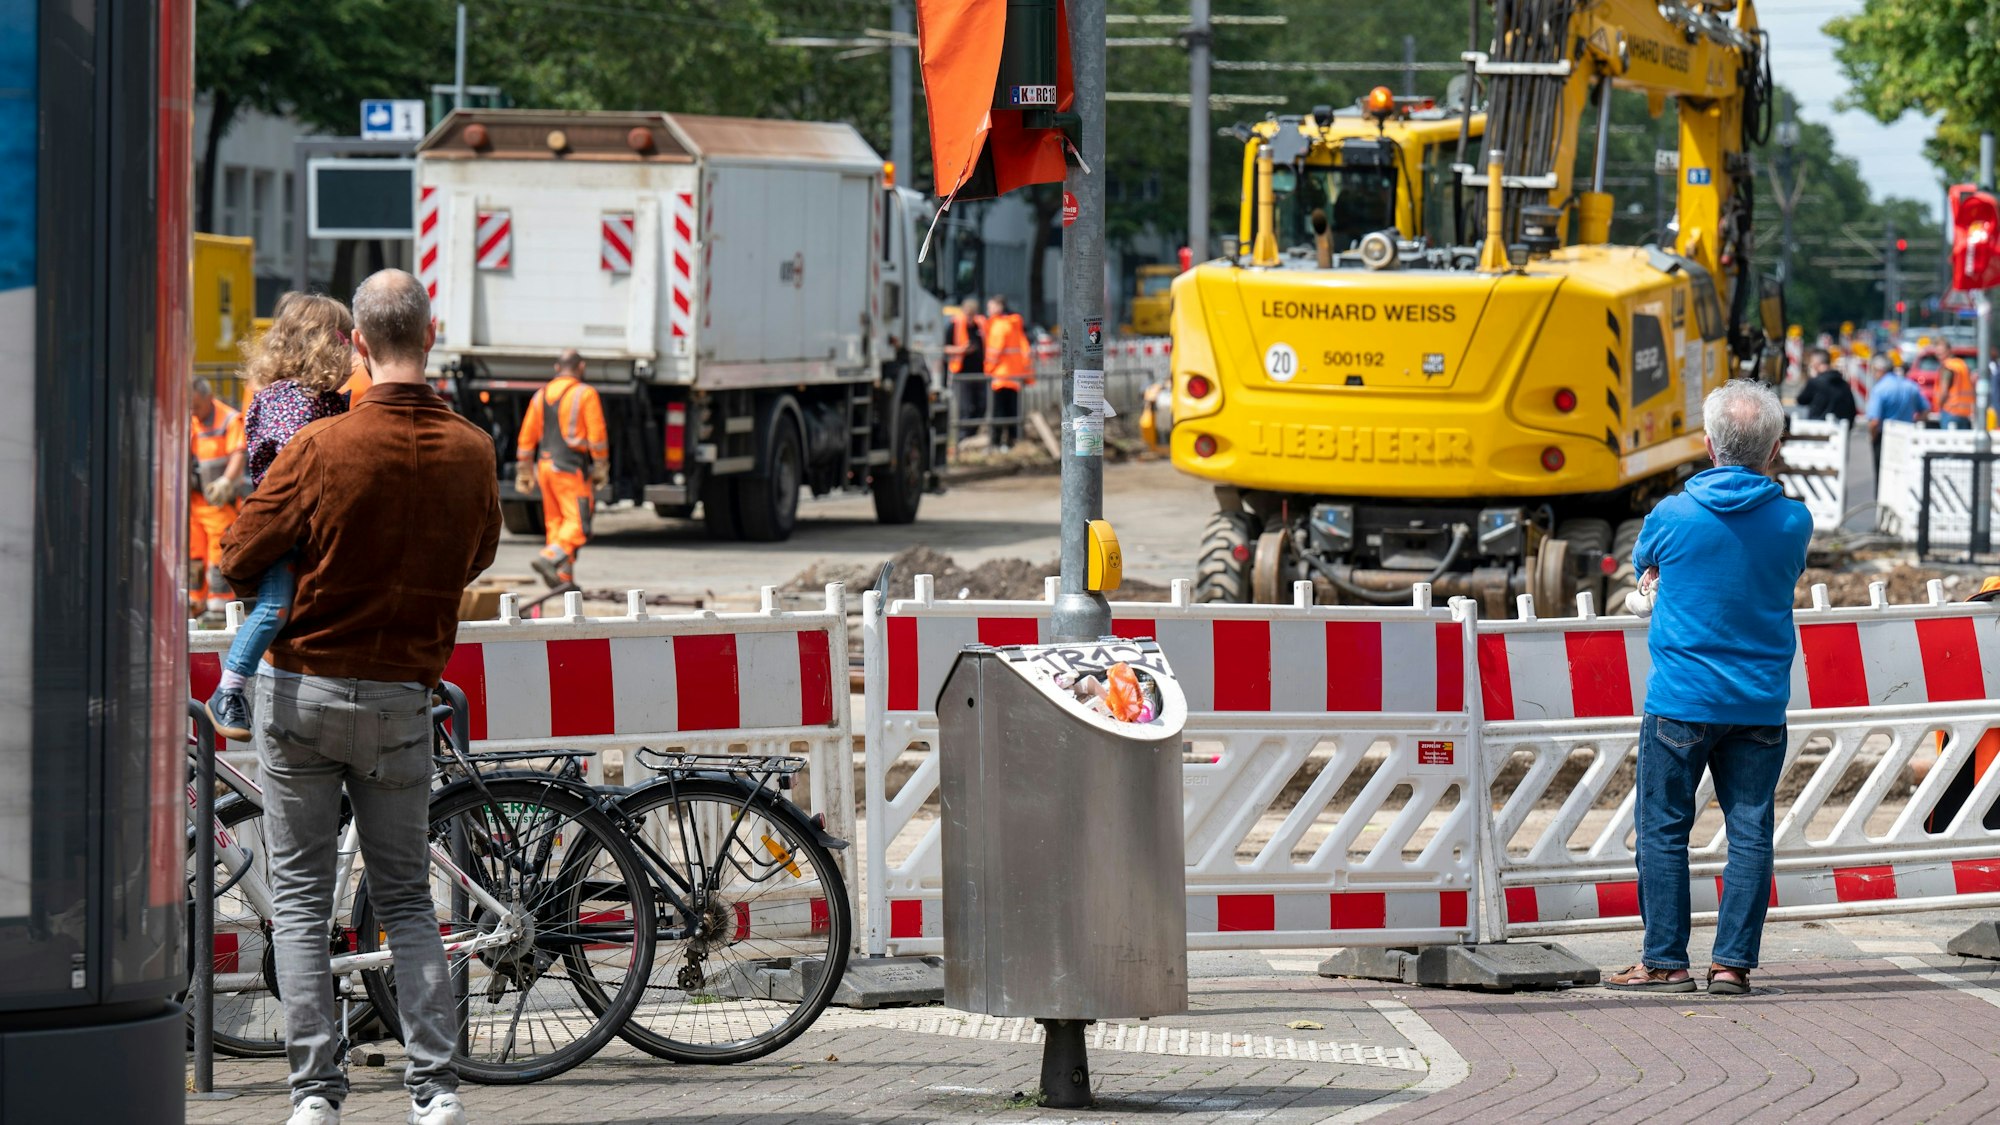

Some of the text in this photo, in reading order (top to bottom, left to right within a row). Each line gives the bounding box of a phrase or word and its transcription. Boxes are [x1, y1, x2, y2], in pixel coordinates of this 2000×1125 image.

[1262, 300, 1457, 323] LEONHARD WEISS
[1271, 351, 1292, 374] 20
[1323, 351, 1385, 368] 500192
[1248, 419, 1474, 466] LIEBHERR
